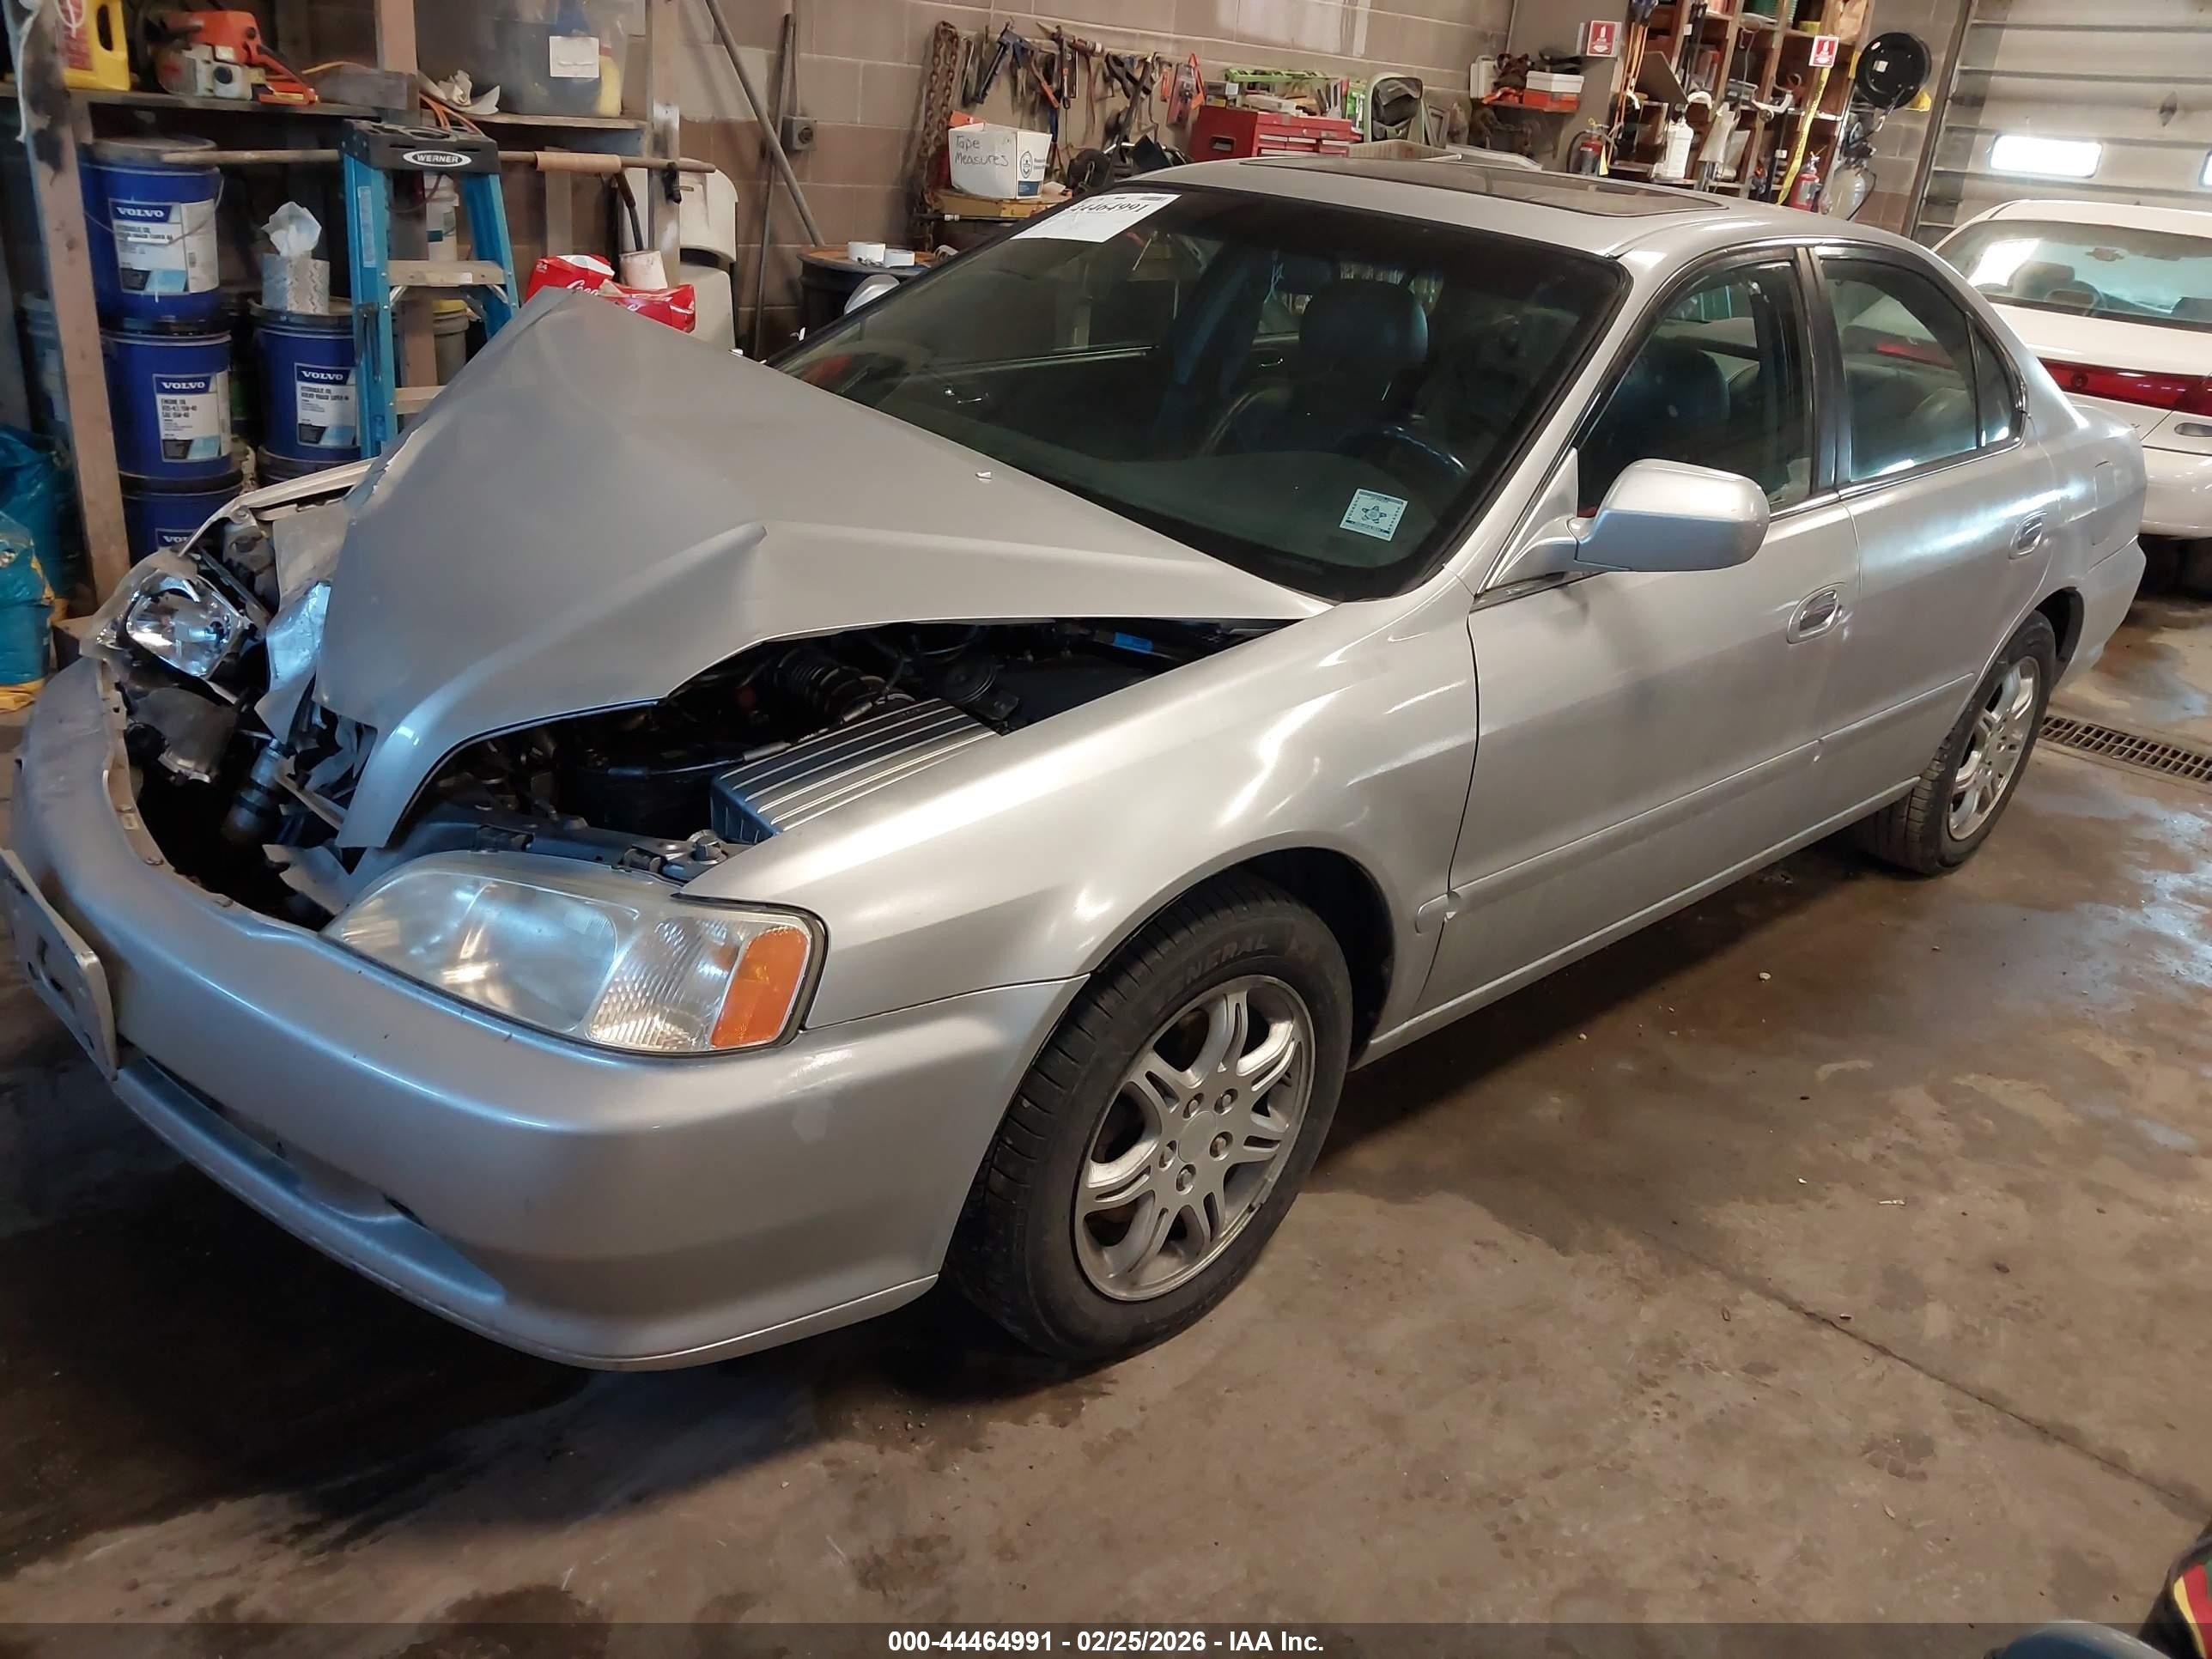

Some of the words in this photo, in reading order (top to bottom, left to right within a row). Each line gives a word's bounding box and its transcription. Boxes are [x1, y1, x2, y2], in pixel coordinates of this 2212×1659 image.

[956, 136, 980, 151] Tape
[416, 154, 459, 163] WERNER
[955, 152, 1009, 167] Measures
[116, 206, 165, 218] VOLVO
[301, 370, 344, 380] VOLVO
[161, 381, 206, 390] VOLVO
